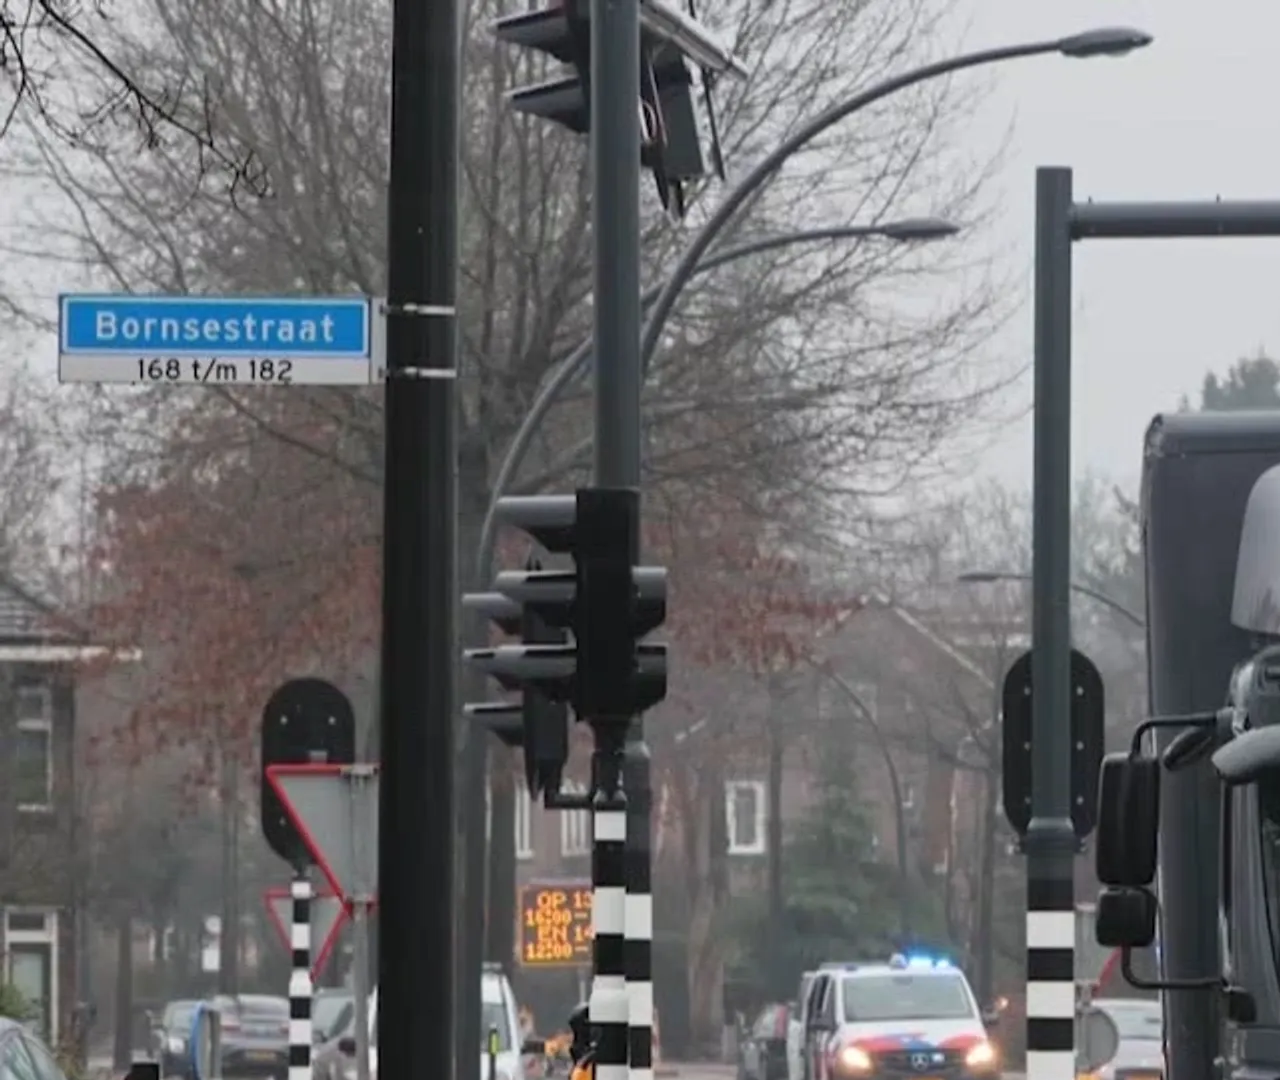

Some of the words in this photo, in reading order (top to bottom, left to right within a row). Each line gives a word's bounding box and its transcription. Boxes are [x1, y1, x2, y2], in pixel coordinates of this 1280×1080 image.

[96, 311, 335, 342] Bornsestraat
[138, 359, 181, 381] 168
[191, 358, 237, 381] t/m
[249, 360, 292, 382] 182
[537, 891, 567, 909] OP
